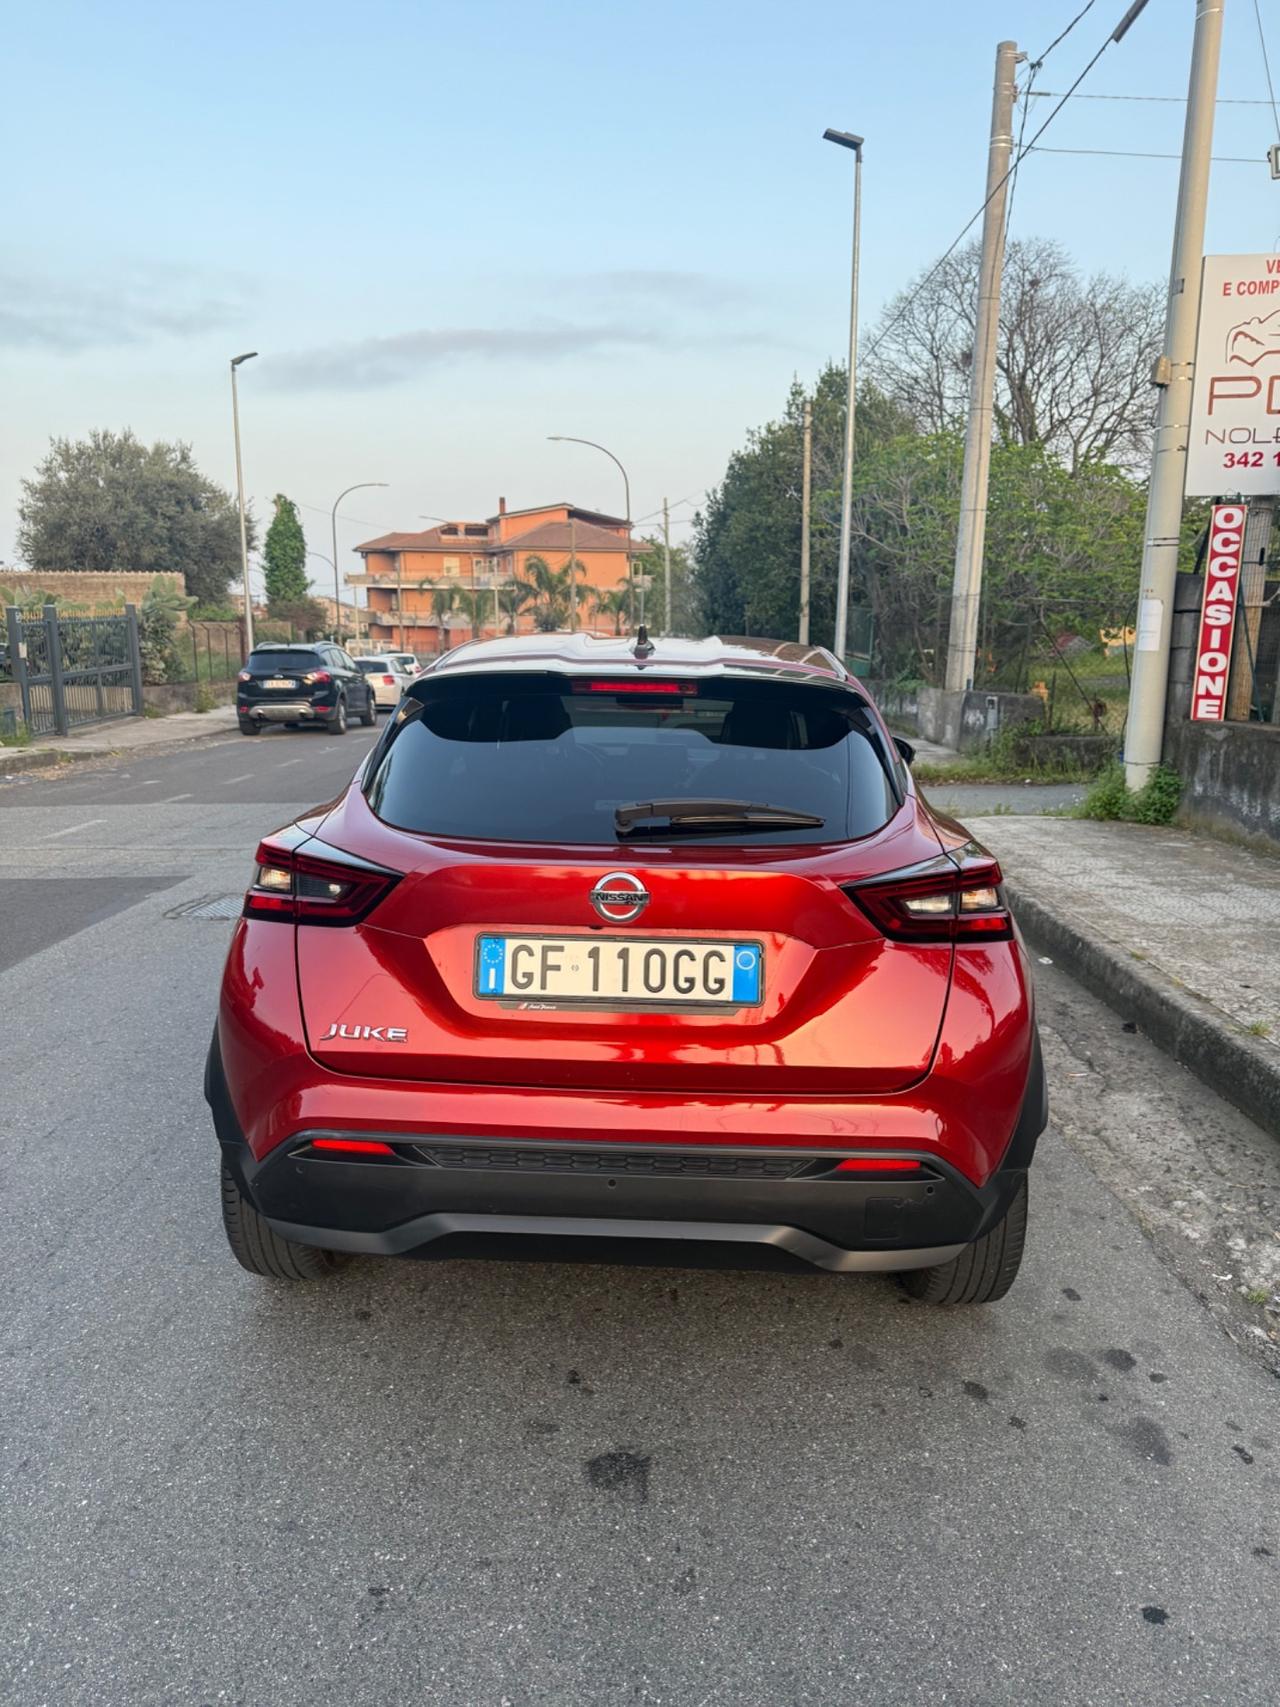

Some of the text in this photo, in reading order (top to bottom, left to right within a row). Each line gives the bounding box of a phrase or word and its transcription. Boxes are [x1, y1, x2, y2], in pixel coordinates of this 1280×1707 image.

[1223, 282, 1232, 296] E
[1207, 374, 1280, 415] P
[1205, 427, 1280, 445] NOL
[1223, 451, 1264, 468] 342
[1196, 507, 1244, 719] OCCASIONE
[595, 892, 644, 902] NISSAN
[511, 944, 565, 990] GF
[587, 946, 726, 995] 110GG
[320, 1023, 408, 1042] JUKE
